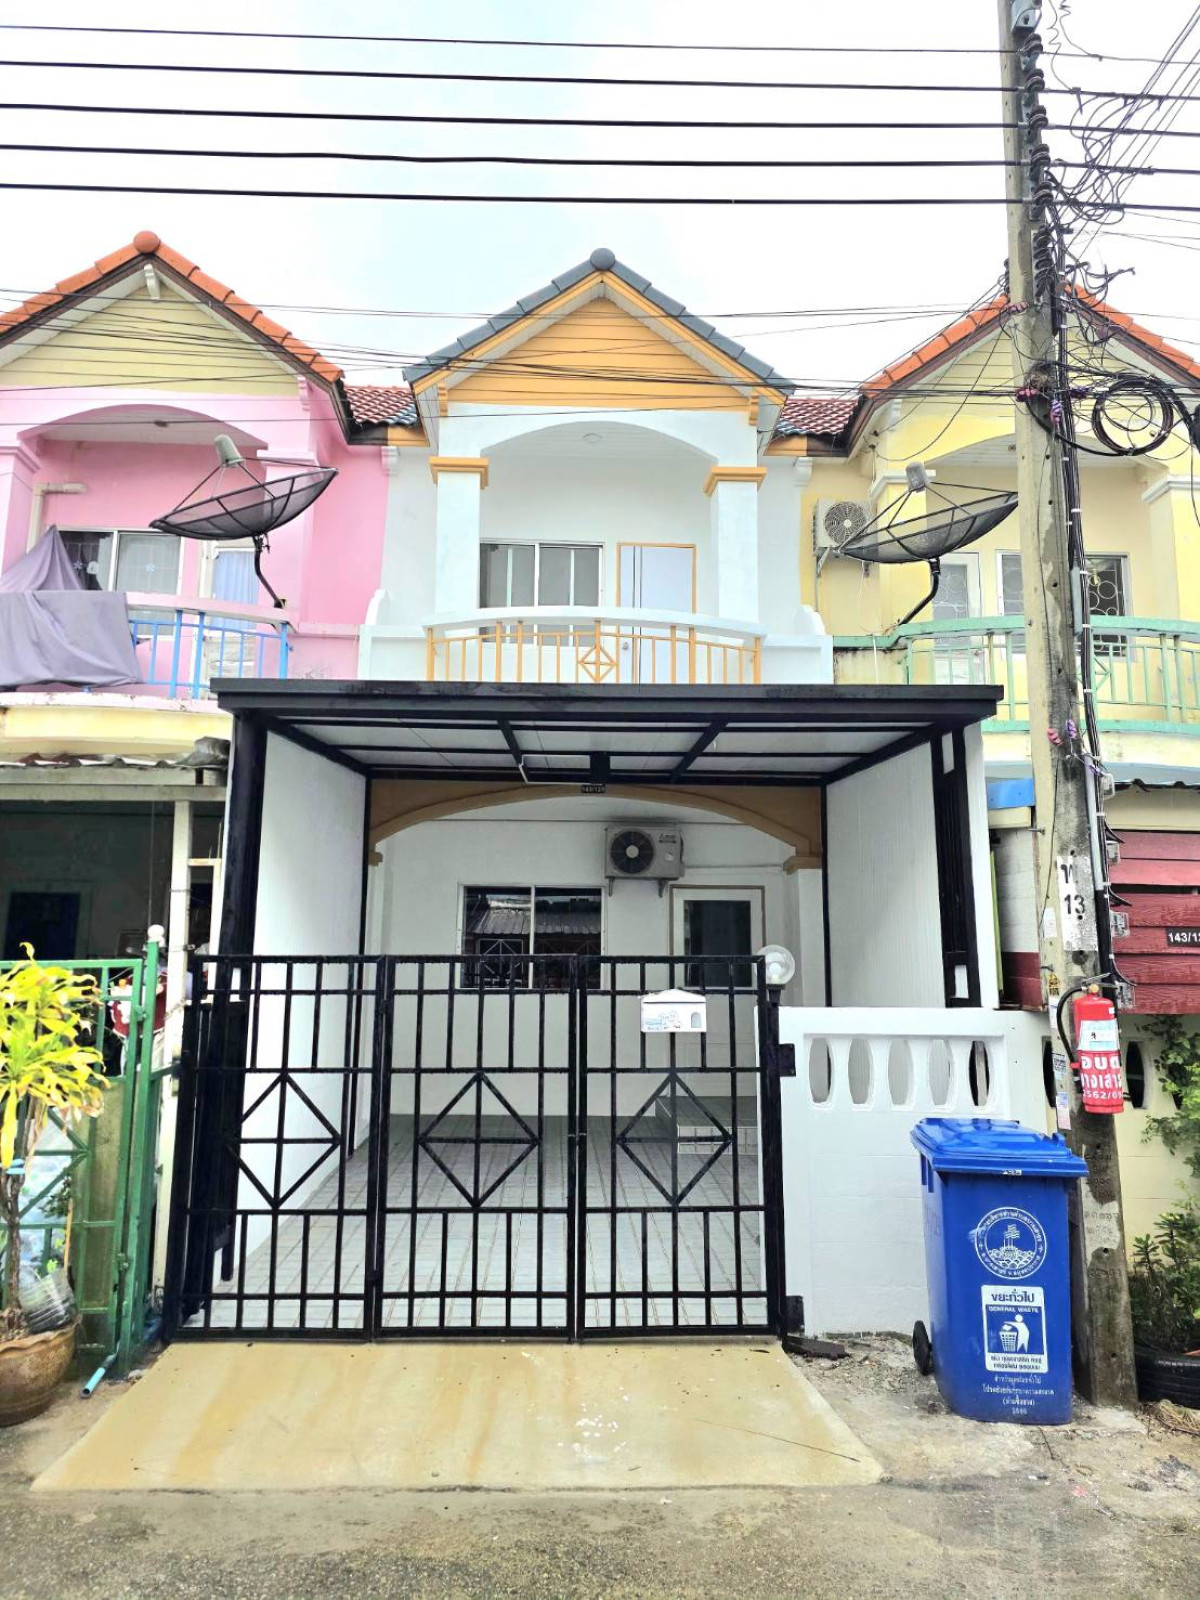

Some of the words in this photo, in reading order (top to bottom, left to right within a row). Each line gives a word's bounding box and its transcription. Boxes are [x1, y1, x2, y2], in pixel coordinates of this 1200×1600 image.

[1064, 894, 1086, 914] 13
[1168, 932, 1200, 943] 143/1
[991, 1288, 1035, 1303] ขยะทั่วไป
